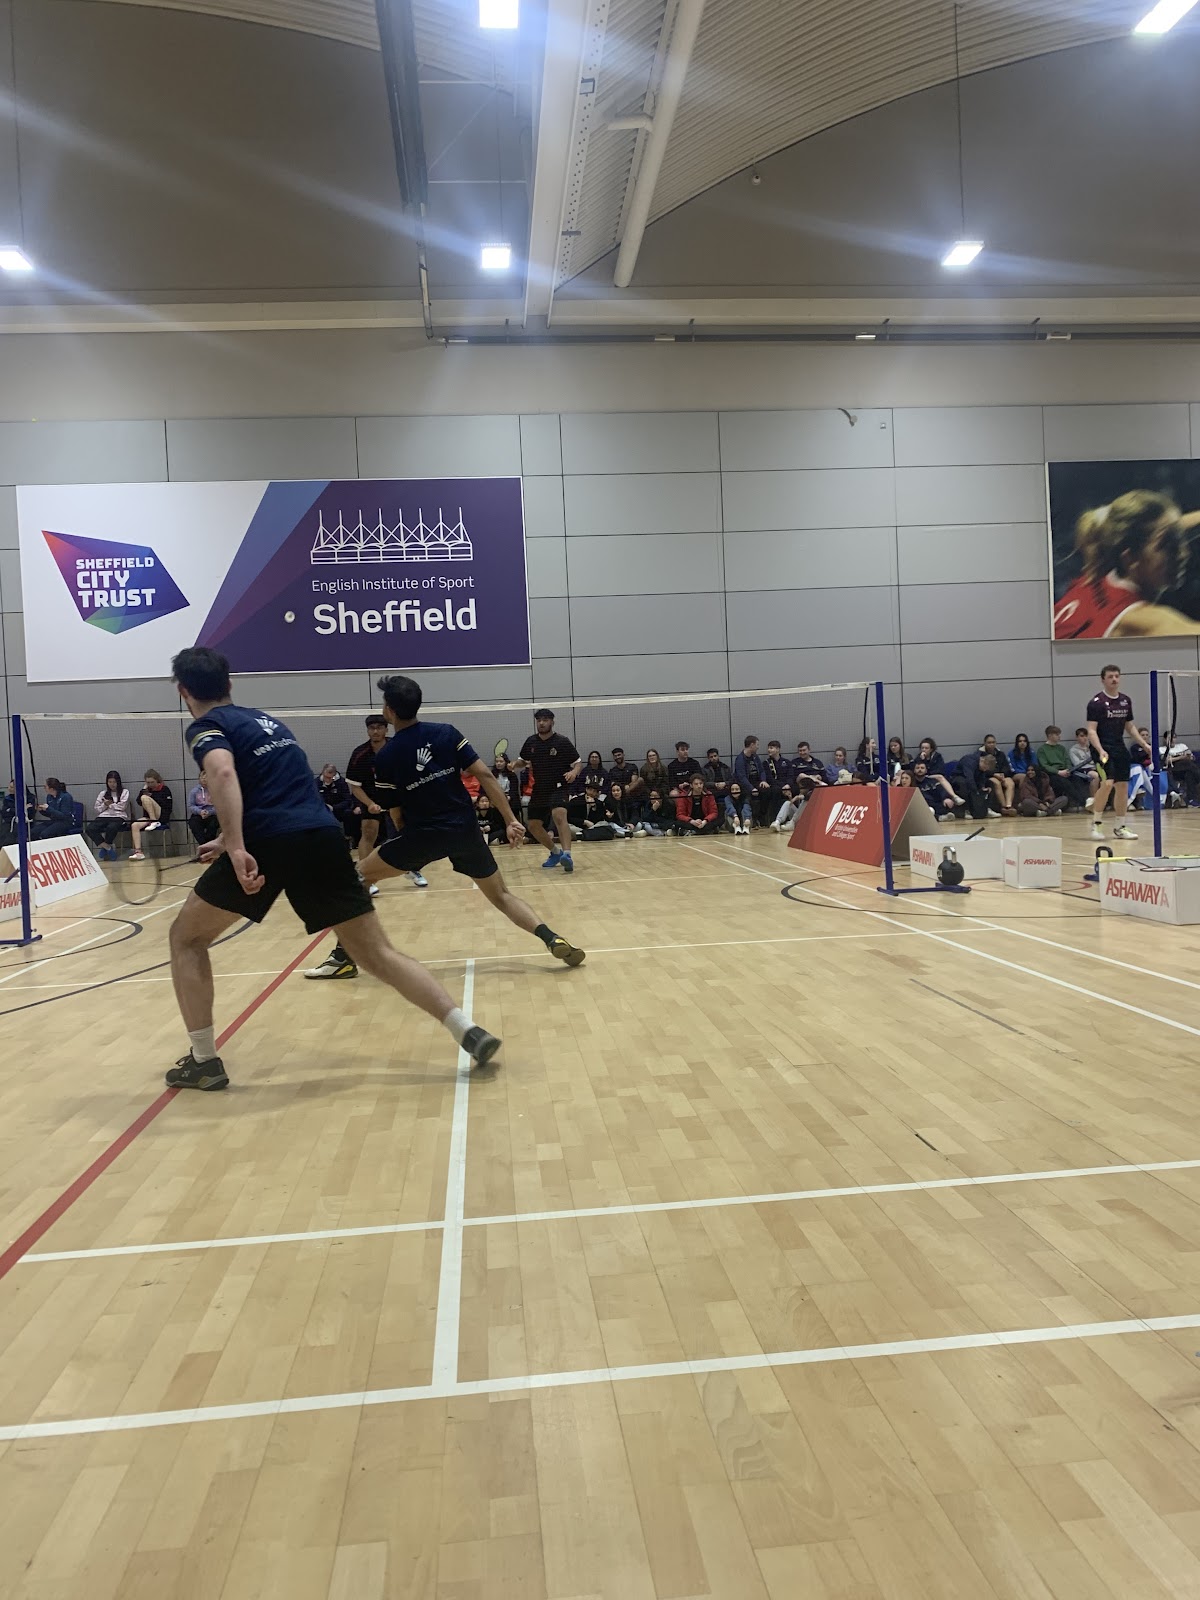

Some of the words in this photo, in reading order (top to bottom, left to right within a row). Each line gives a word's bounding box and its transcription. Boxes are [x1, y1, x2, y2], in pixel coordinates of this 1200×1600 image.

[76, 557, 154, 569] SHEFFIELD
[77, 570, 130, 588] CITY
[312, 579, 359, 594] English
[362, 577, 419, 590] Institute
[421, 576, 436, 589] of
[438, 576, 474, 591] Sport
[78, 588, 156, 608] TRUST
[313, 598, 477, 635] Sheffield
[838, 804, 869, 825] BUCS
[912, 848, 933, 866] ASHAWAY
[1105, 878, 1161, 905] ASHAWAY
